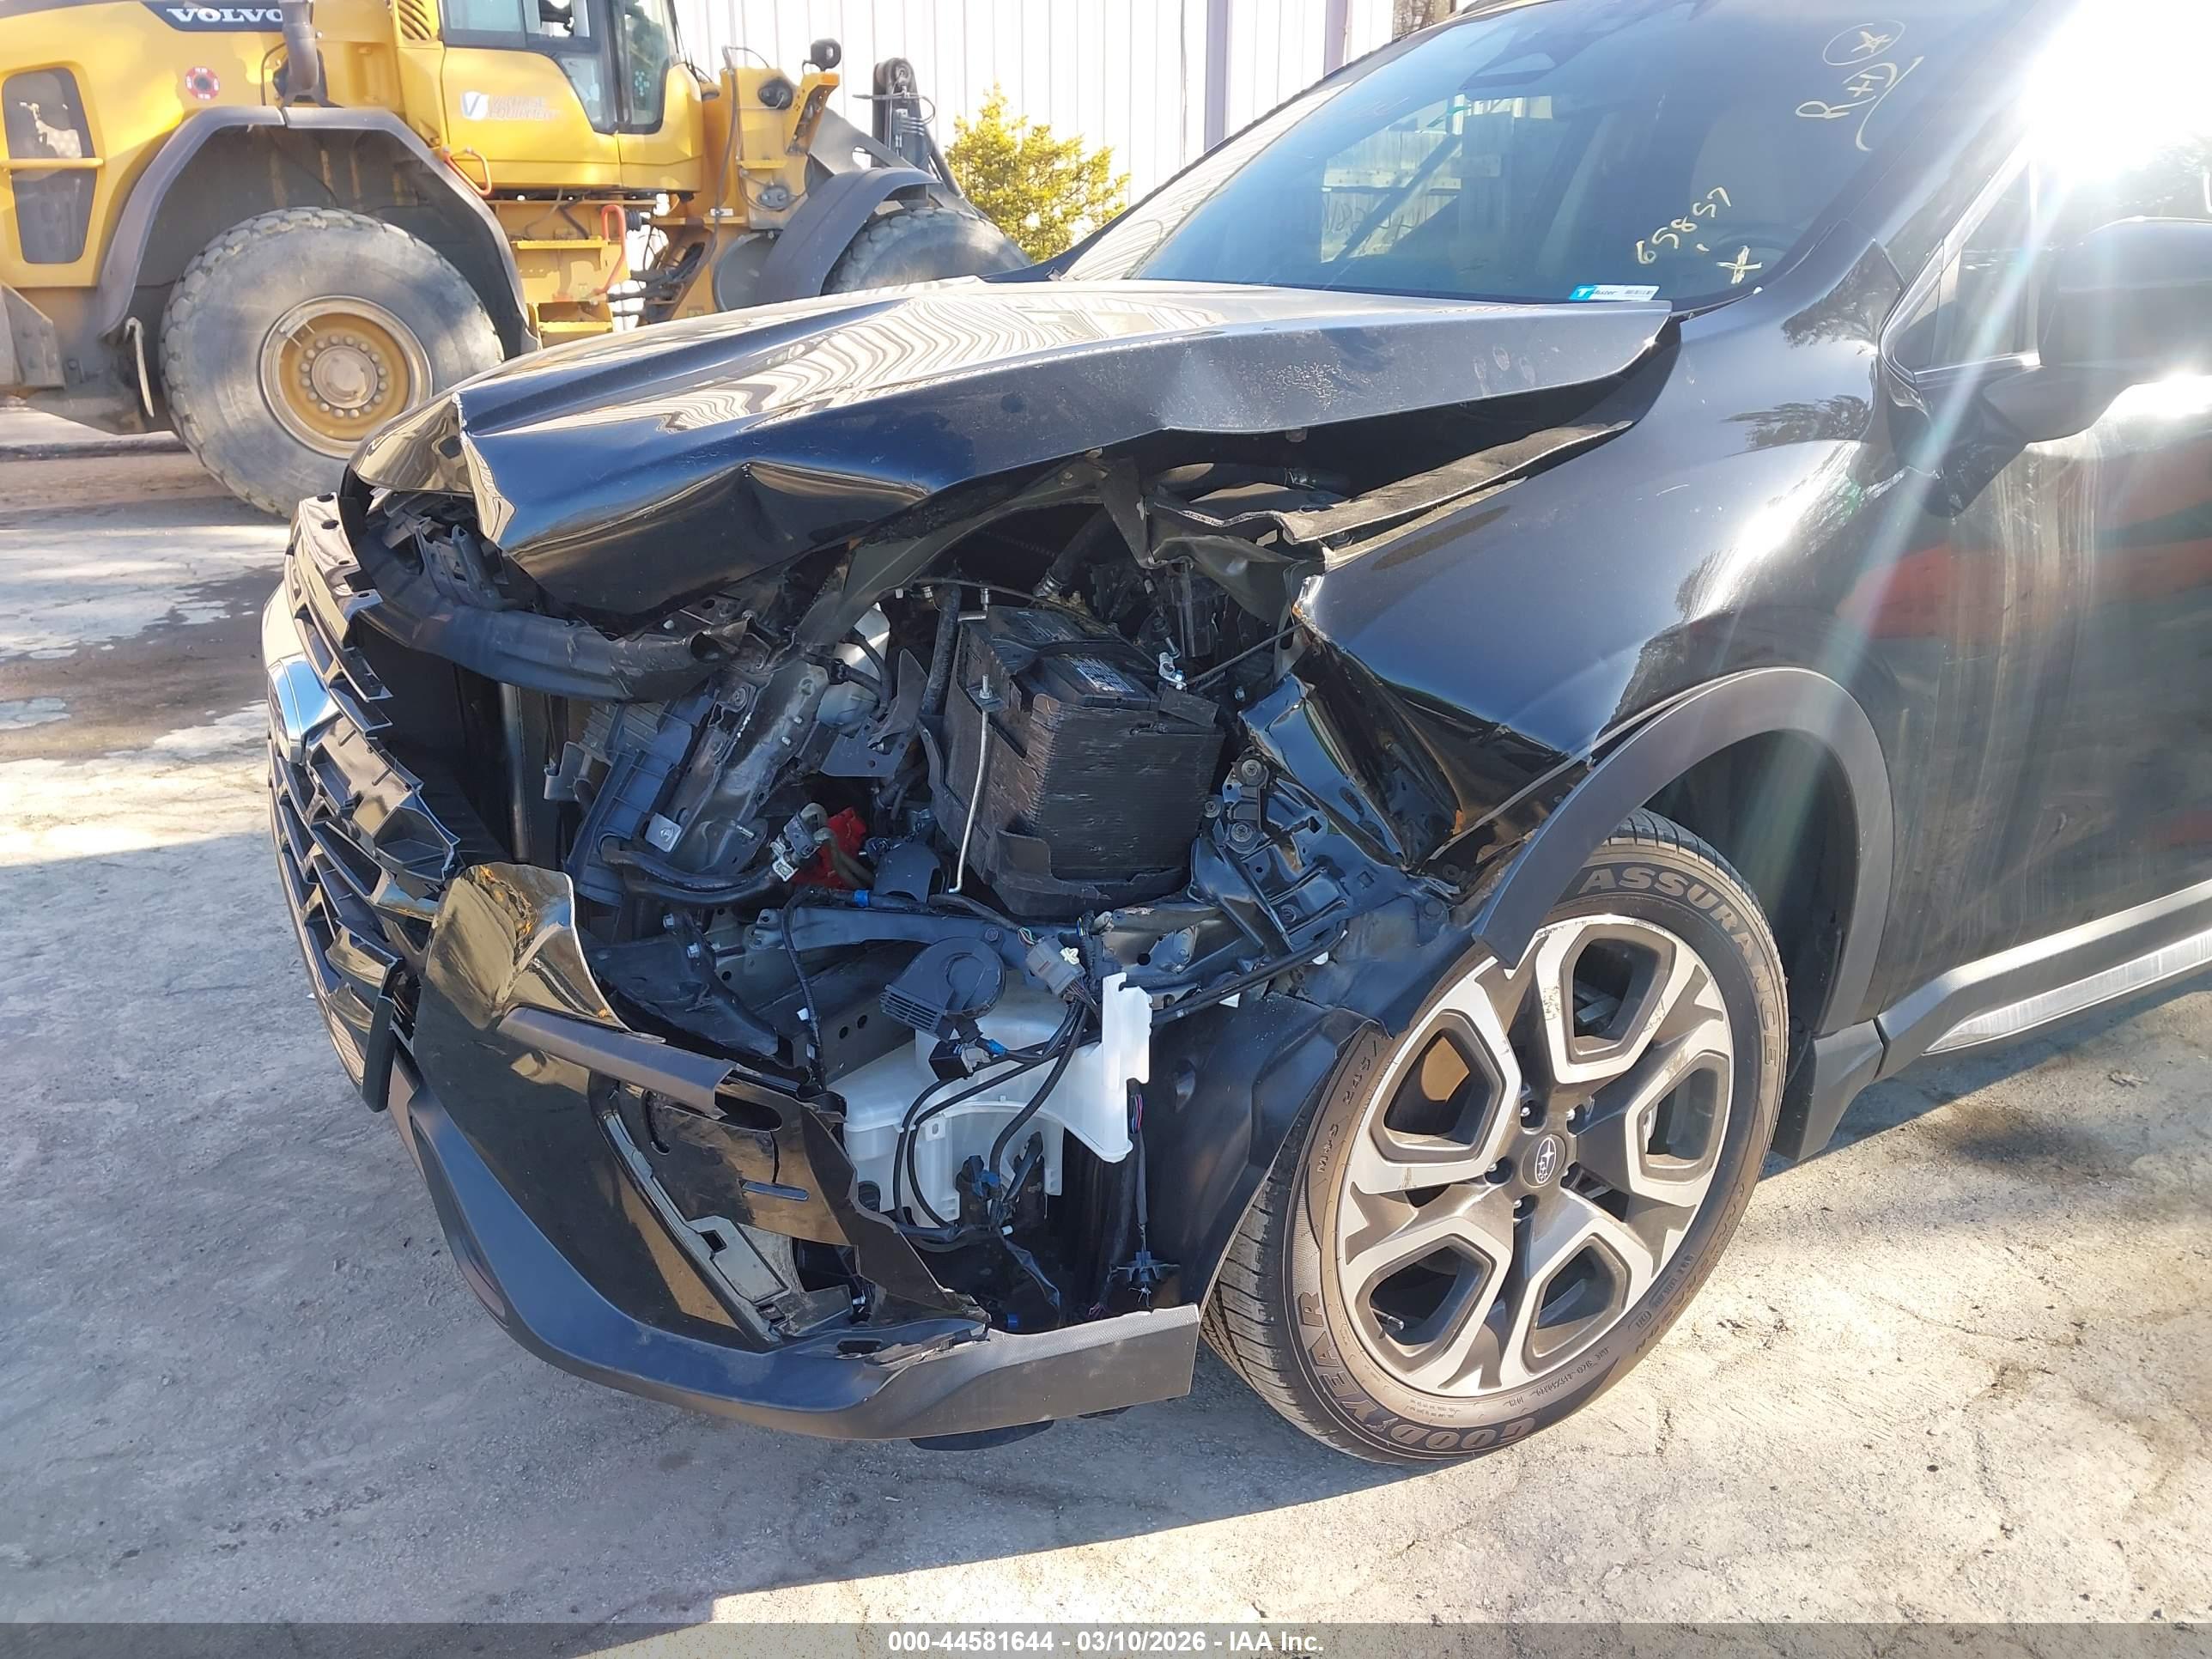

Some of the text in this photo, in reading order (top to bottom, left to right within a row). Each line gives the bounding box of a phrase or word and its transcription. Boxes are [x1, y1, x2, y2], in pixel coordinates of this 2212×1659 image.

[166, 8, 283, 22] VOLVO
[1577, 866, 1778, 1066] ASSURANCE
[1299, 1292, 1535, 1449] GOODYEAR
